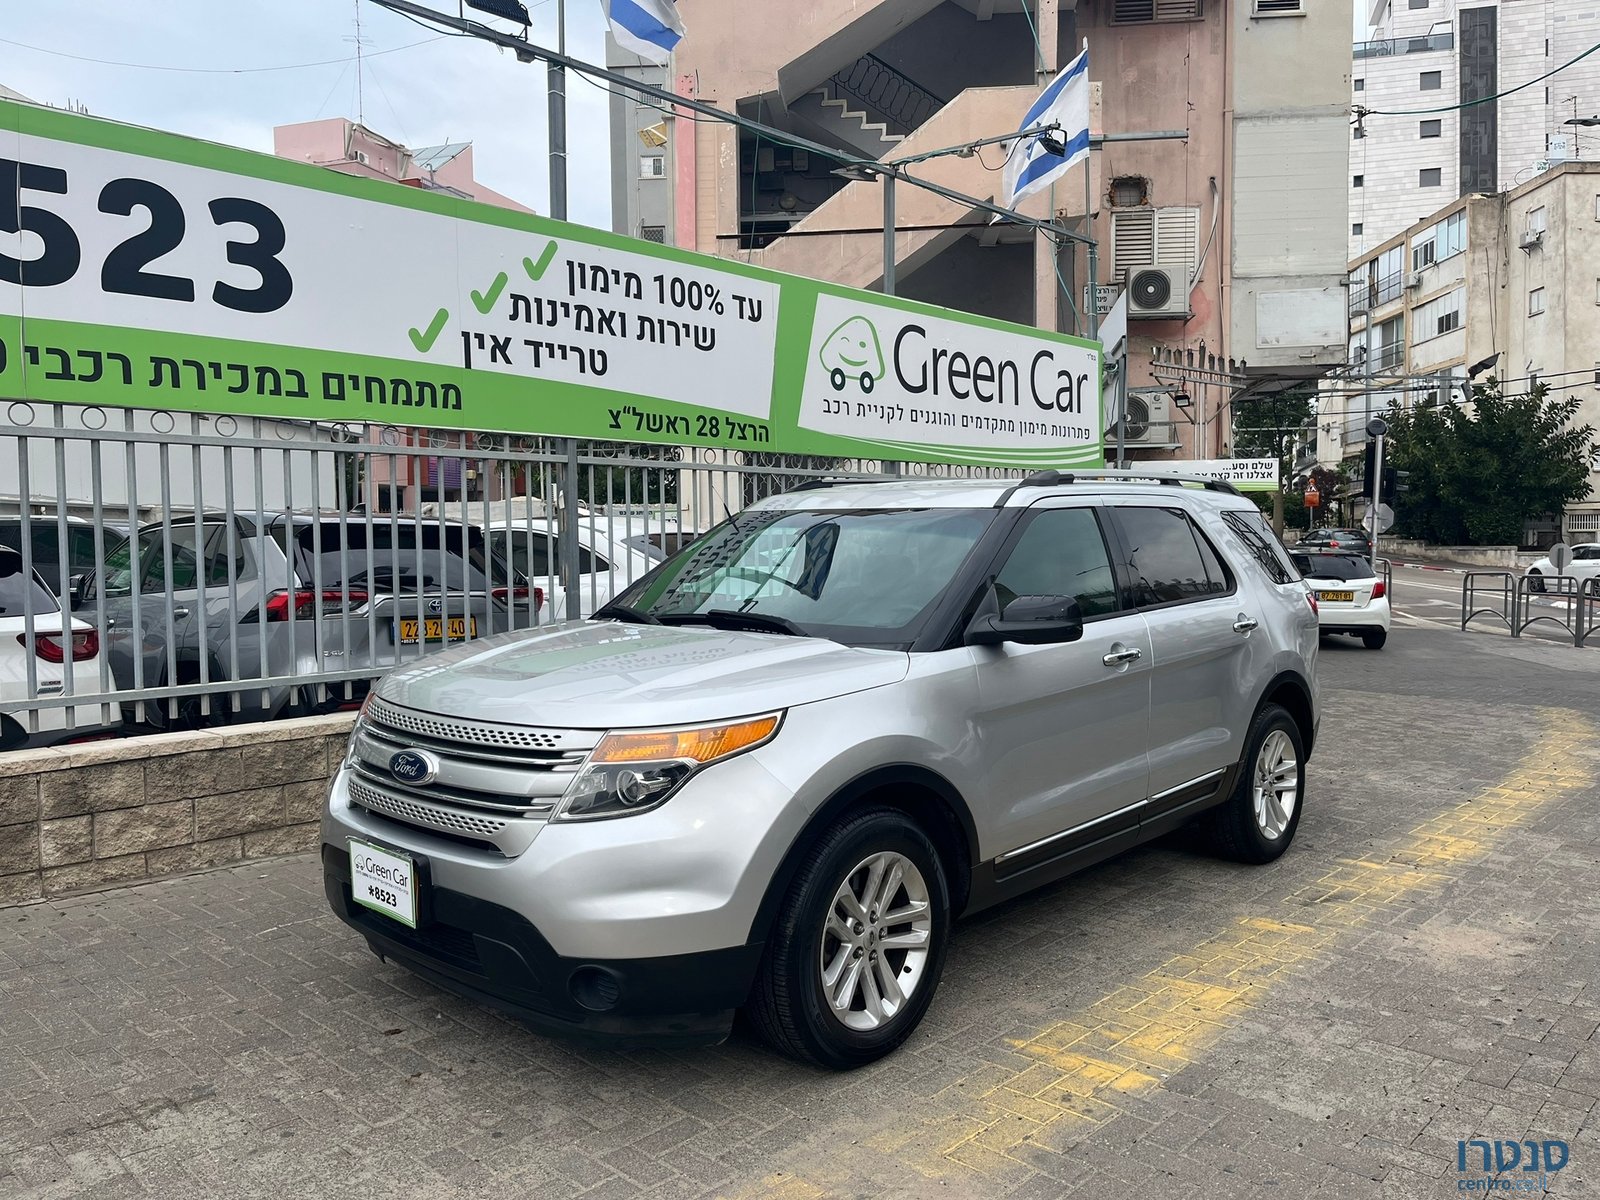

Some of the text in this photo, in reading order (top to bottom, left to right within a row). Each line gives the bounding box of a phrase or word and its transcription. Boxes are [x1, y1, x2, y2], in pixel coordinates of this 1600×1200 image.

[566, 259, 762, 323] עד 100% מימון
[509, 292, 716, 352] שירות ואמינות
[24, 345, 133, 385] רכבי
[461, 330, 608, 376] טרייד אין
[893, 324, 1089, 414] Green Car
[149, 355, 309, 399] במכירת
[322, 372, 462, 411] מתמחים
[696, 415, 720, 438] 28
[725, 416, 770, 443] הרצל
[822, 399, 1090, 440] פתרונות מימון מתקדמים והוגנים לקניית רכב
[1233, 471, 1243, 479] זה
[1246, 470, 1273, 479] אצלנו
[1251, 461, 1273, 470] שלם
[394, 754, 420, 777] Ford
[365, 857, 392, 881] Green
[393, 868, 408, 888] Car
